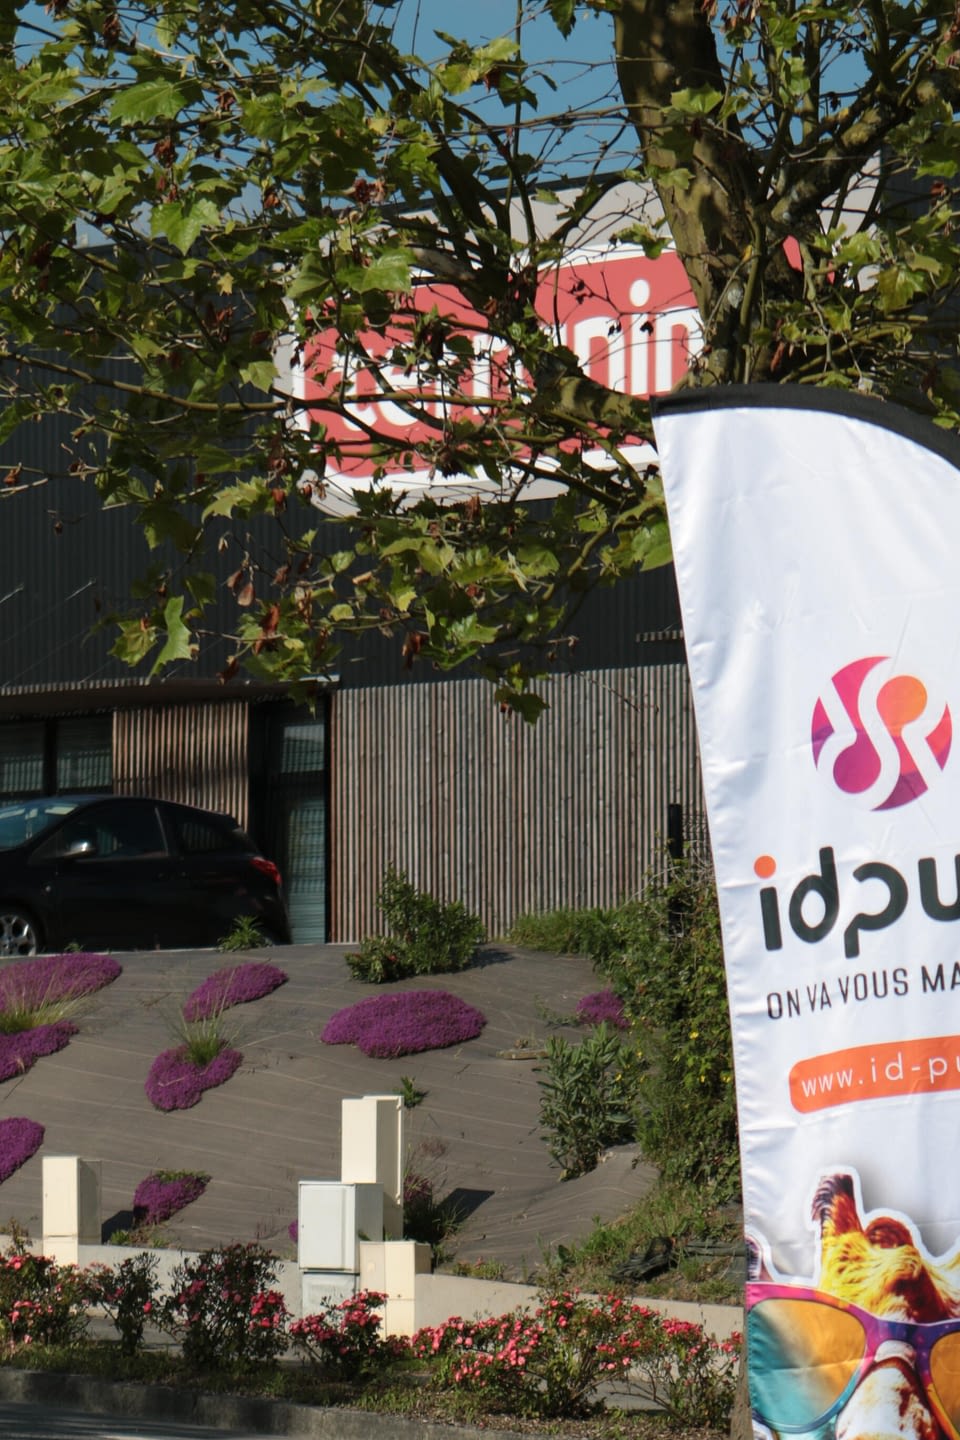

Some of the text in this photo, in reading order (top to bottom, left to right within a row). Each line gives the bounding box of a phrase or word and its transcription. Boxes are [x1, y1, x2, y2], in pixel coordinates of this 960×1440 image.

[766, 989, 801, 1021] ON
[806, 981, 833, 1011] VA
[838, 967, 909, 1005] VOUS
